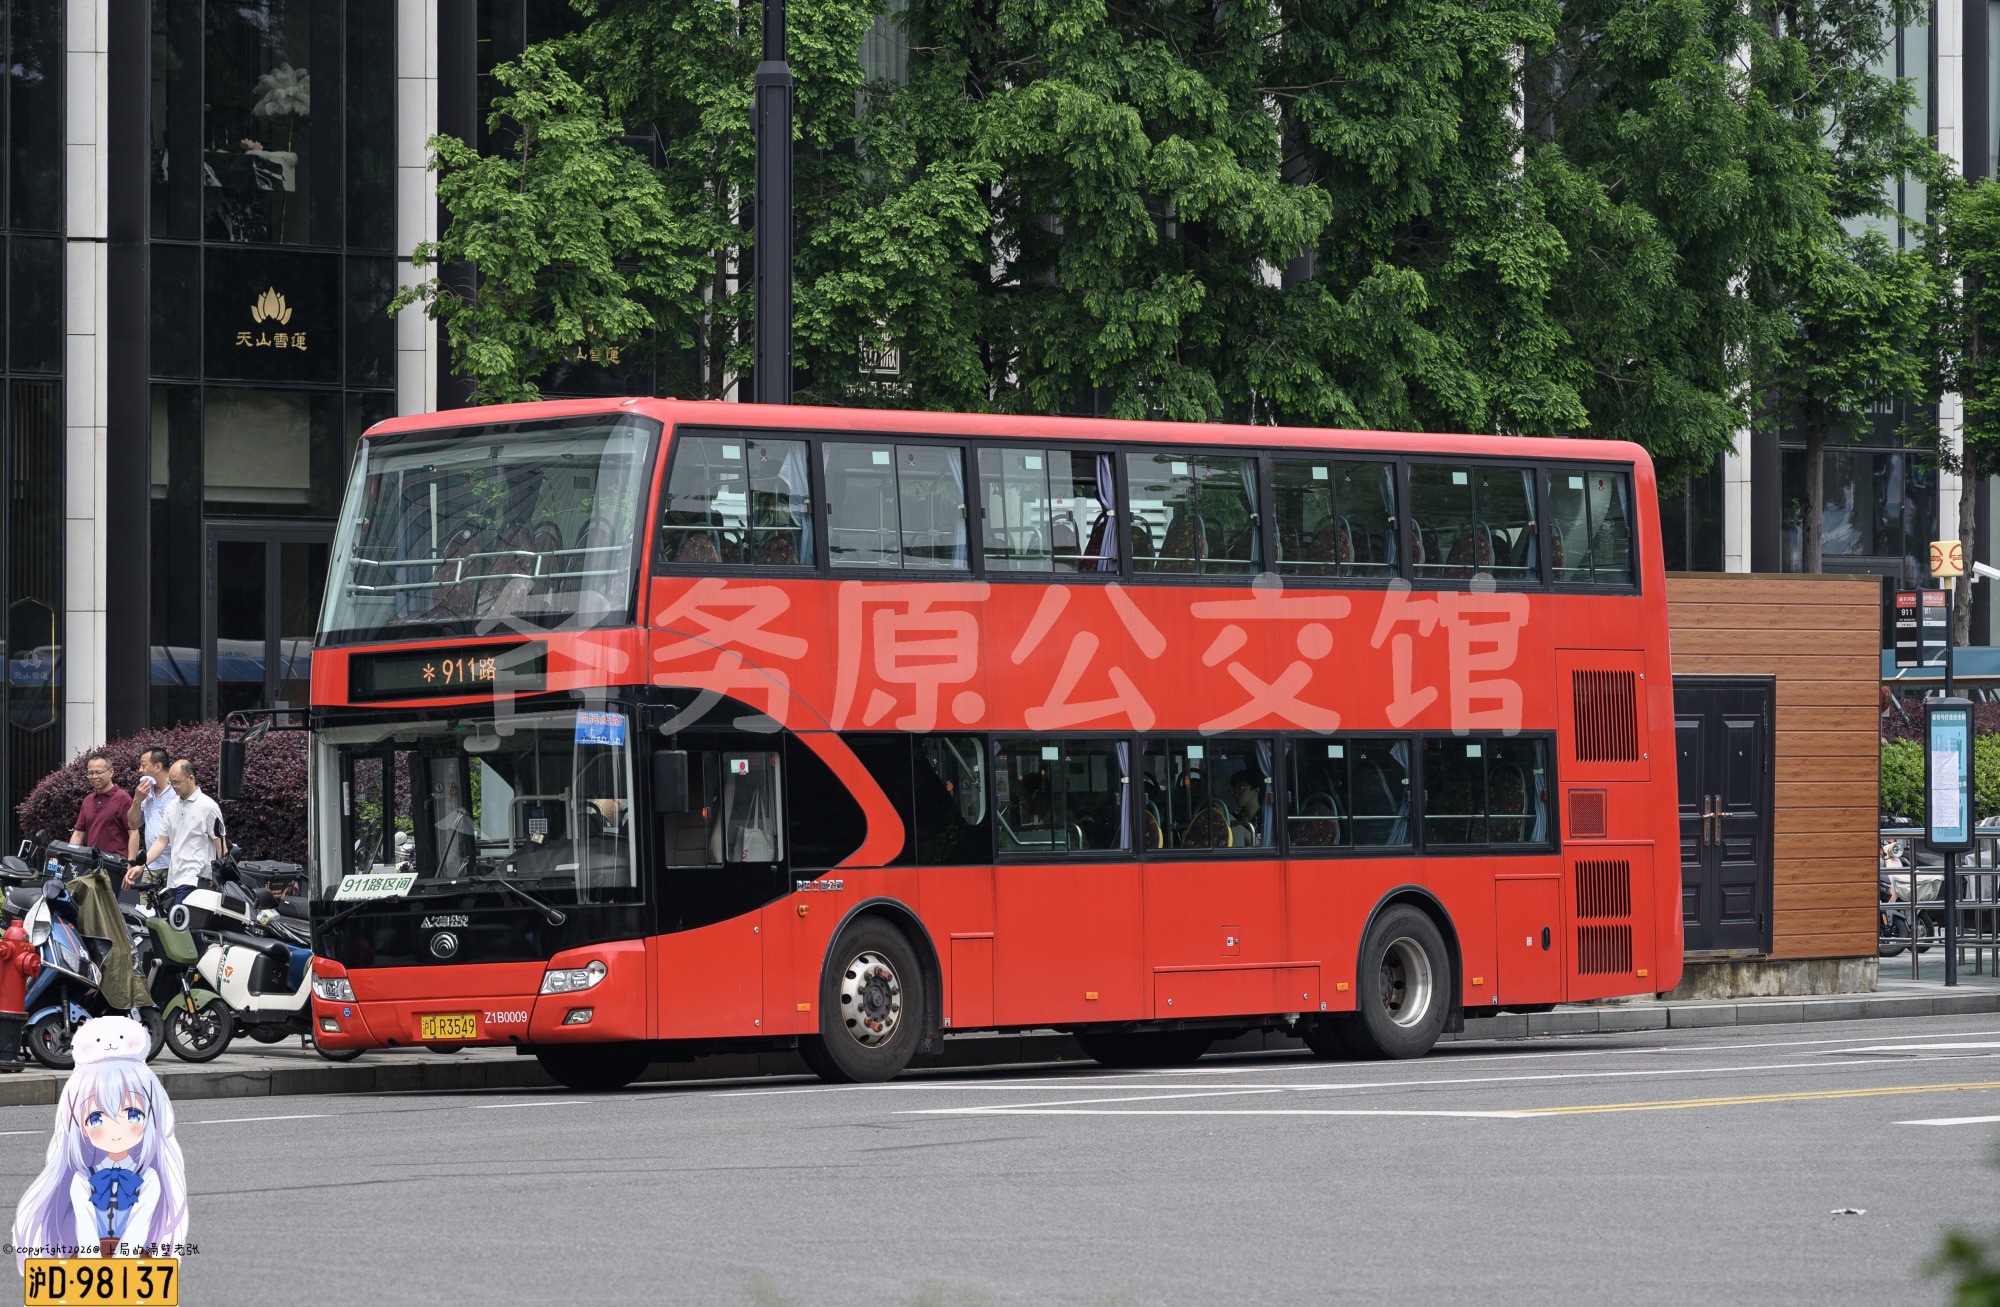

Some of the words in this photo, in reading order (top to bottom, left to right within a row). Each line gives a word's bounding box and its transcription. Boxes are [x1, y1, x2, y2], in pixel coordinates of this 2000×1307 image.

[235, 331, 307, 351] 天山雪蓮
[562, 346, 620, 364] 山雪蓮
[1901, 608, 1913, 616] 911
[342, 877, 412, 892] 911路区间
[484, 1011, 528, 1024] Z1B0009
